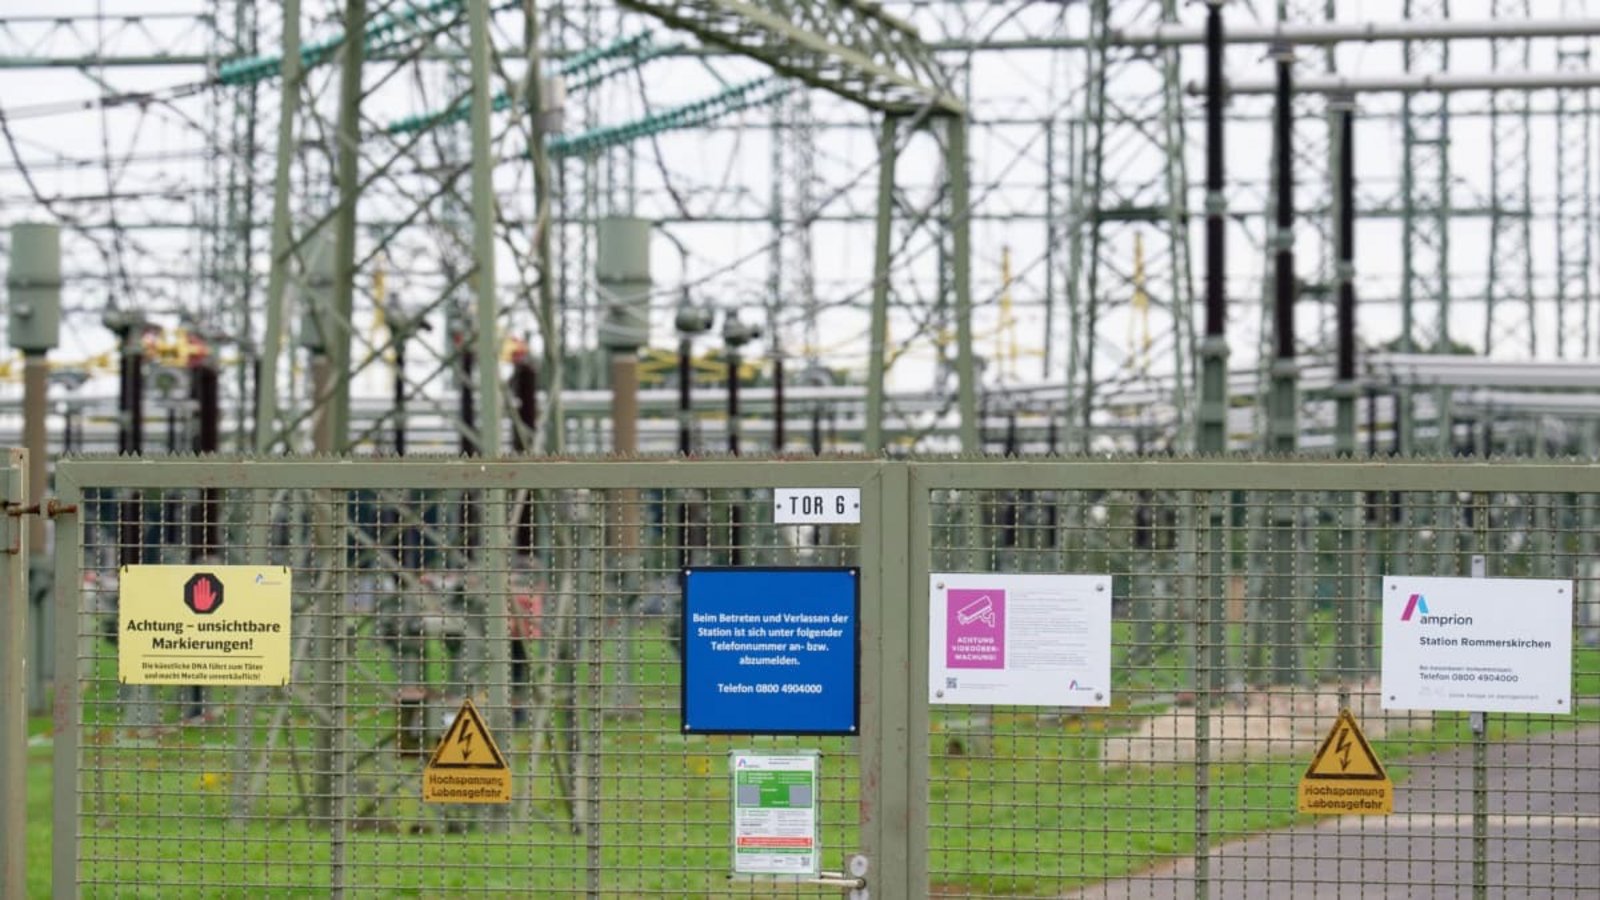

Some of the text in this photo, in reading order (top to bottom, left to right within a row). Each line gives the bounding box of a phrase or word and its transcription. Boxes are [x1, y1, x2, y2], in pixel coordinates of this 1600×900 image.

[789, 495, 845, 515] TOR 6
[692, 613, 849, 623] Beim Betreten und Verlassen der
[1420, 613, 1473, 627] amprion
[127, 619, 184, 634] Achtung
[197, 620, 280, 633] unsichtbare
[698, 627, 843, 639] Station ist sich unter folgender
[152, 638, 253, 653] Markierungen!
[711, 641, 829, 651] Telefonnummer an- bzw.
[957, 636, 994, 644] ACHTUNG
[1419, 636, 1551, 649] Station Rommerskirchen
[739, 655, 800, 665] abzumelden.
[1419, 672, 1519, 682] Telefon 0800 4904000
[717, 683, 822, 694] Telefon 0800 4904000
[429, 772, 503, 786] Hochspannung
[1304, 785, 1385, 798] Hochspannung
